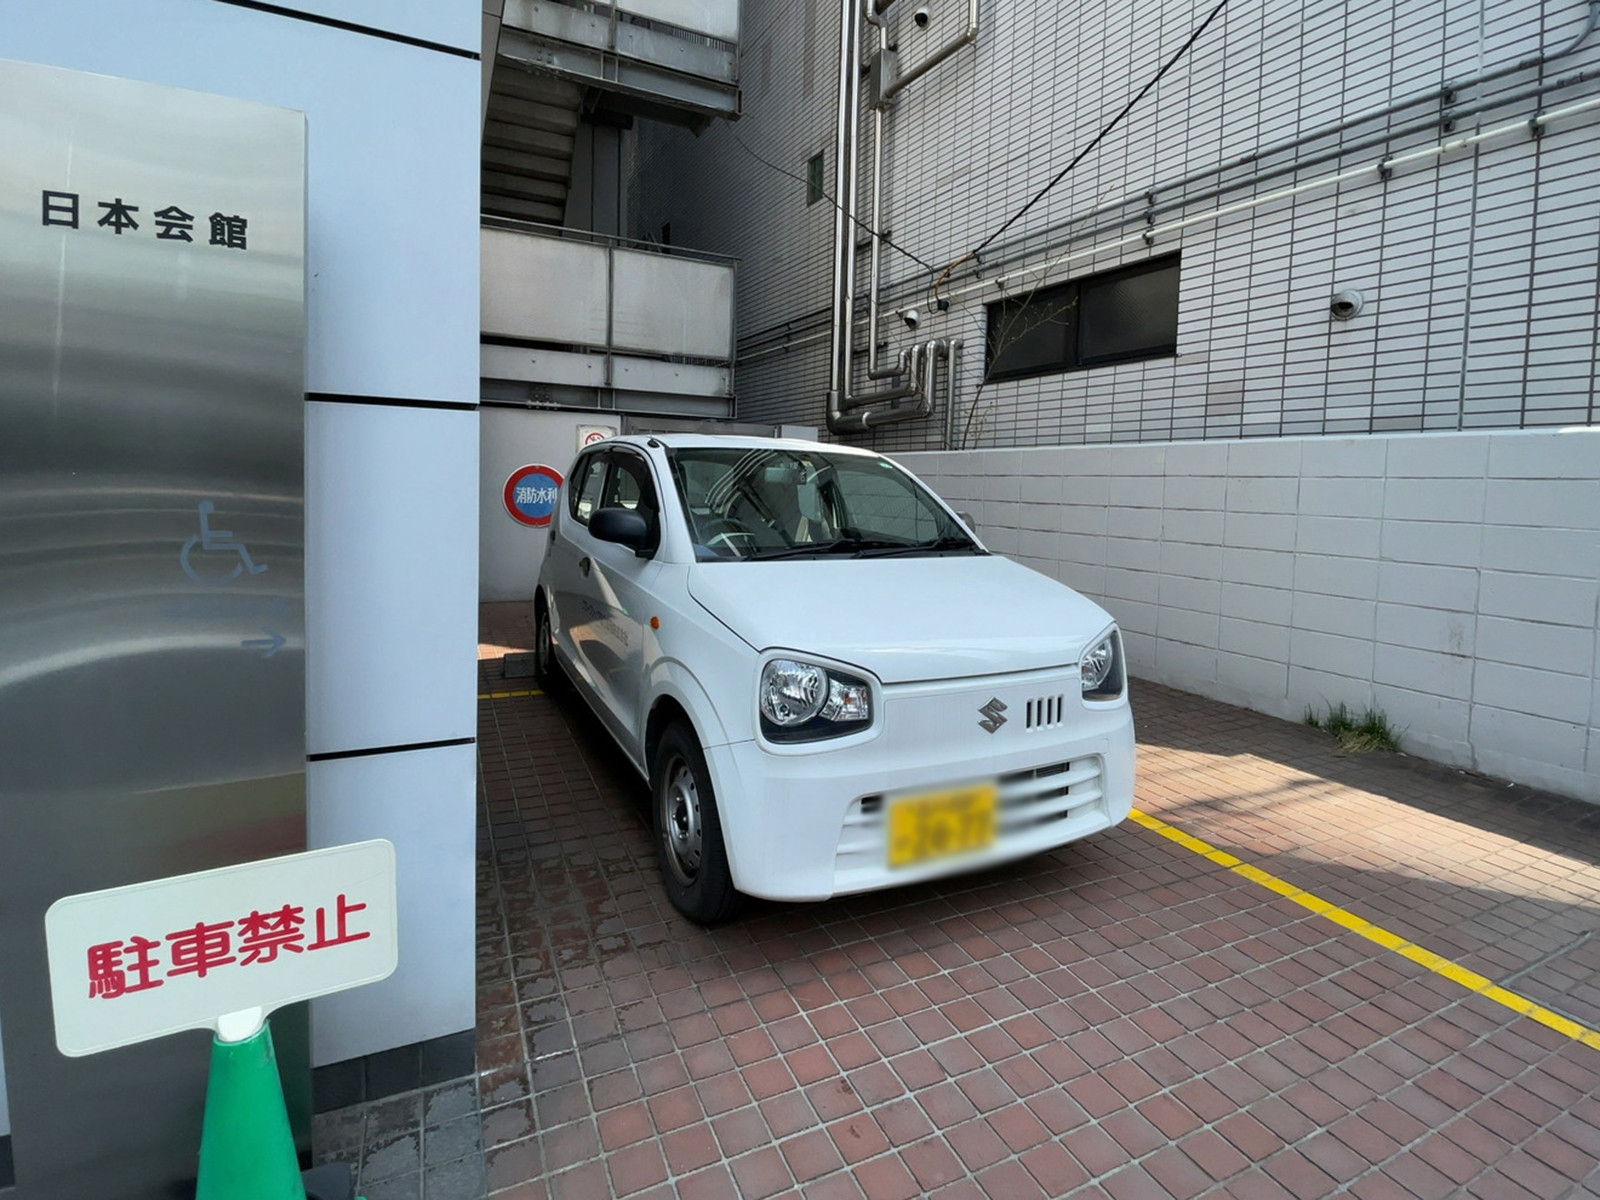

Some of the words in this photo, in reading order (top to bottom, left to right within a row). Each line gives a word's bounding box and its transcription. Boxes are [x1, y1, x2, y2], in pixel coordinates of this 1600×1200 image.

[42, 190, 248, 250] 日本会館
[515, 486, 559, 505] 消防水利
[87, 894, 371, 999] 駐車禁止
